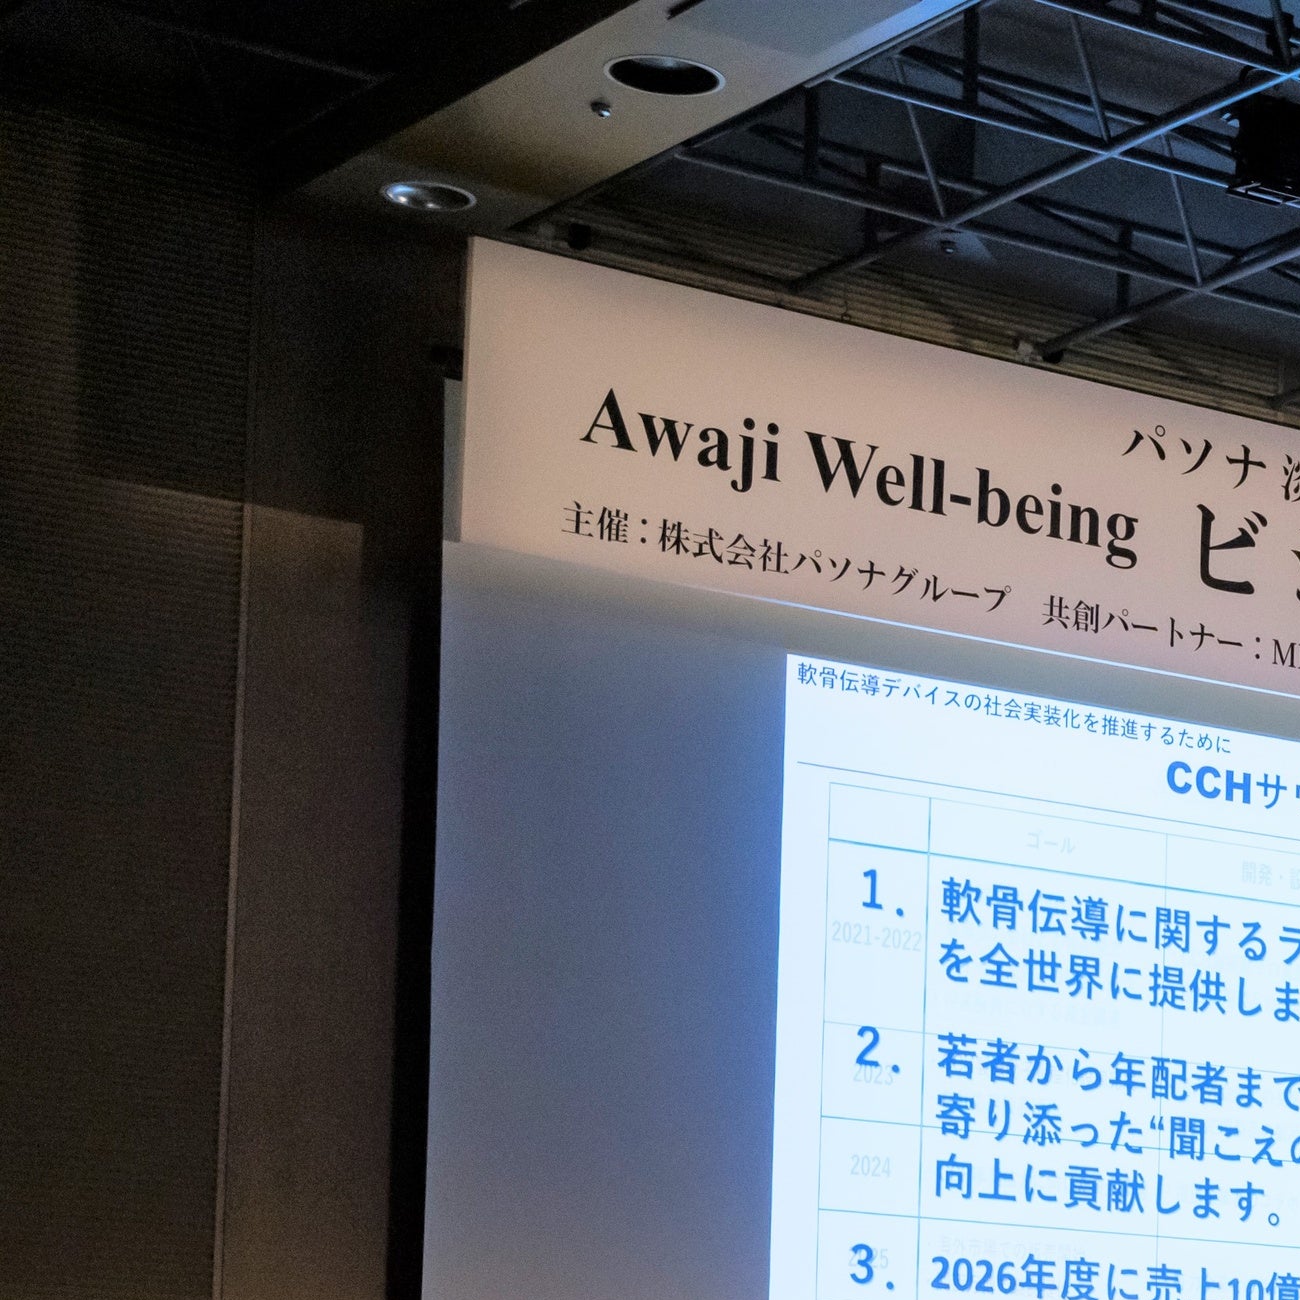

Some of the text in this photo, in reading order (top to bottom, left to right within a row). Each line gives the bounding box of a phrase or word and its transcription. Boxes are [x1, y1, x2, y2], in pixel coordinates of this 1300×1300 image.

[581, 388, 782, 494] Awaji
[805, 430, 1140, 569] Well-being
[797, 661, 1232, 755] 軟骨伝導デバイスの社会実装化を推進するために
[850, 1154, 892, 1178] 2024
[933, 1152, 1281, 1228] 向上に貢献します。
